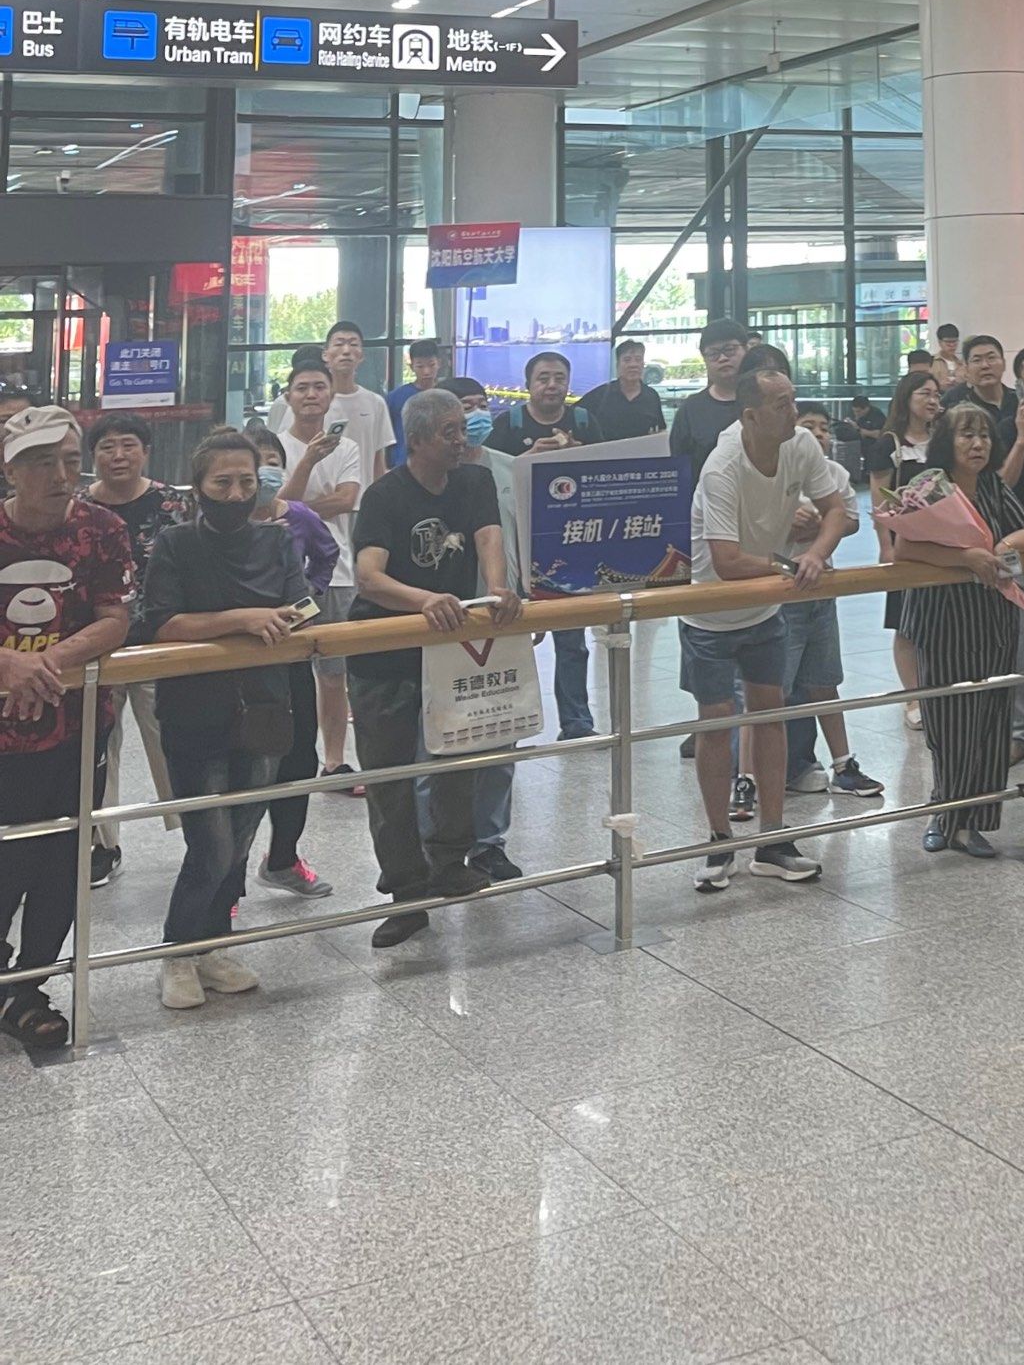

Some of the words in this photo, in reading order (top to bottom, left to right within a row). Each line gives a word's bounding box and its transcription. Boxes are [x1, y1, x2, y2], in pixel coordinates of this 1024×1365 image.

[22, 10, 64, 35] 巴士
[164, 15, 255, 44] 有轨电车
[318, 22, 391, 48] 网约车
[22, 39, 55, 58] Bus
[164, 44, 211, 63] Urban
[213, 46, 254, 65] Tram
[318, 49, 336, 67] Ride
[362, 51, 390, 69] Service
[446, 56, 497, 73] Metro
[562, 518, 604, 545] 接机
[622, 513, 664, 540] 接站
[452, 668, 518, 694] 韦德教育
